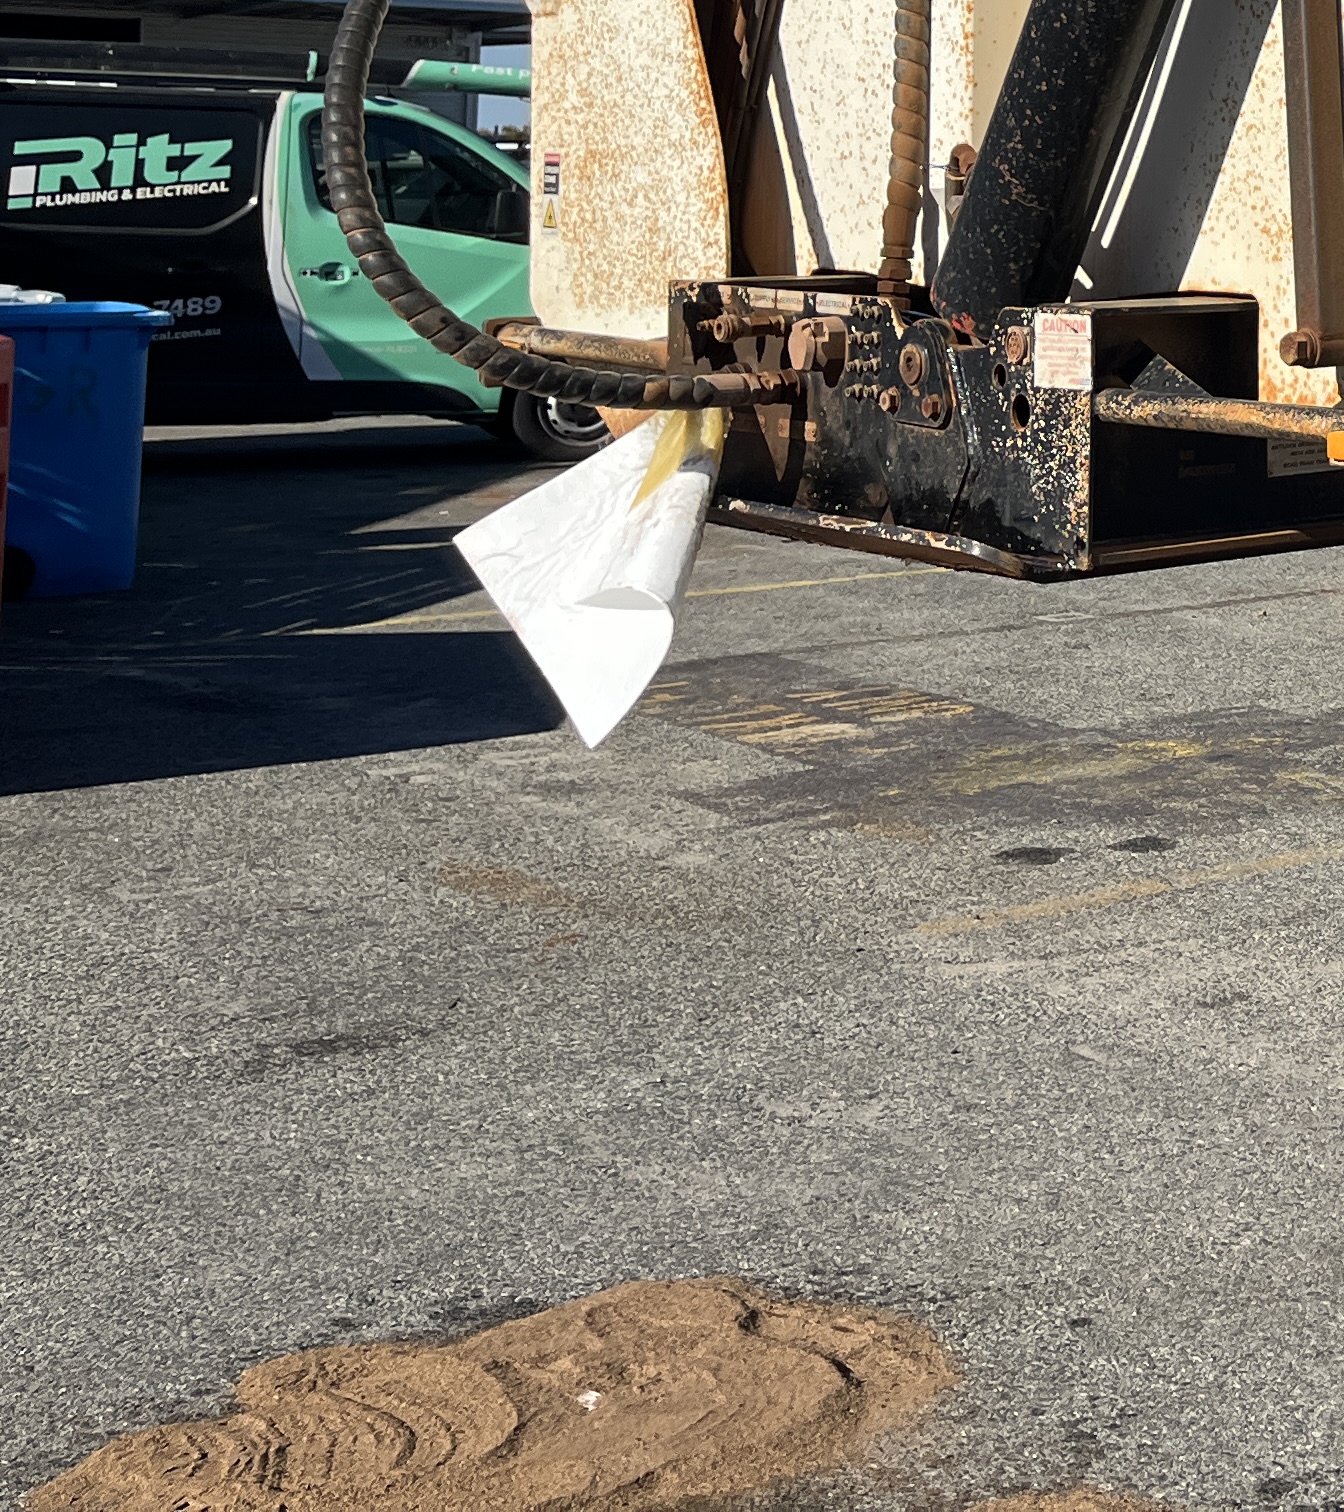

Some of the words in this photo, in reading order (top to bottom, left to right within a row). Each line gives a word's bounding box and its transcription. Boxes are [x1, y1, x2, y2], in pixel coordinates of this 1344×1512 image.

[11, 132, 234, 195] Ritz
[35, 188, 119, 209] PLUMBING
[121, 187, 133, 201] &
[135, 180, 230, 200] ELECTRICAL
[1042, 317, 1087, 334] CAUTION
